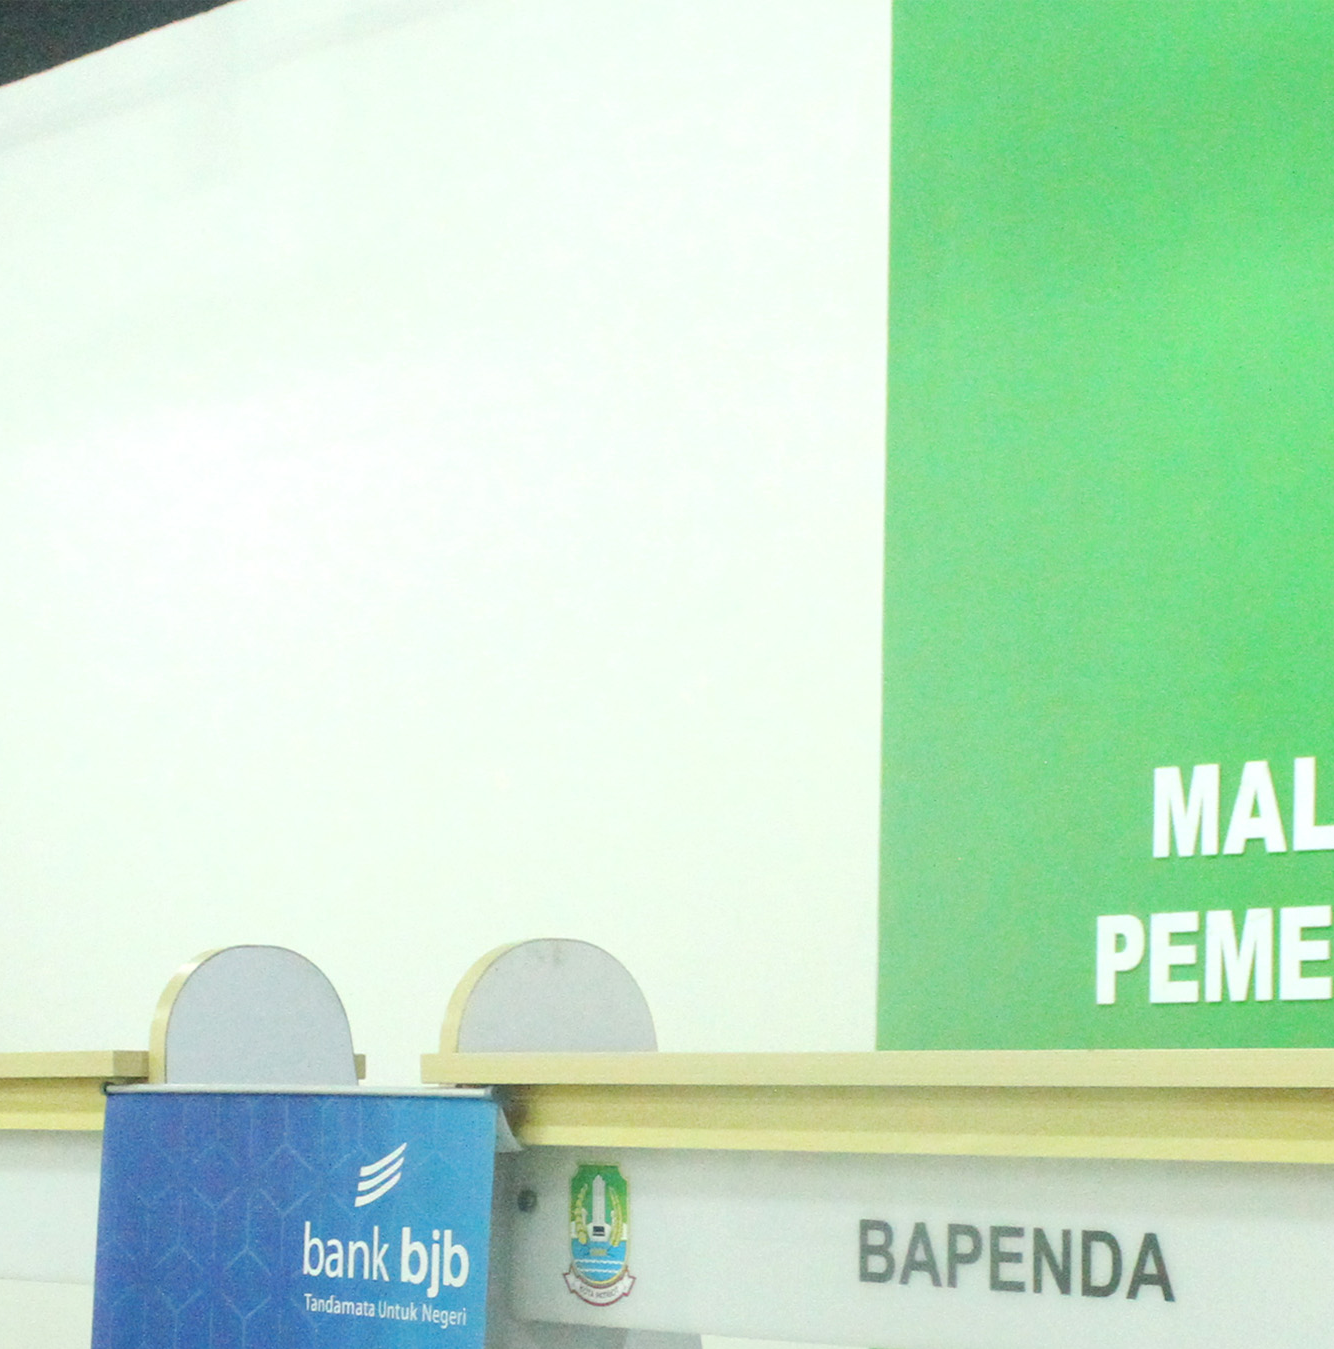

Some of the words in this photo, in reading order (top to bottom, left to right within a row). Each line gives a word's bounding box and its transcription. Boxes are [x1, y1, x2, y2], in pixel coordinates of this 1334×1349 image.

[302, 1221, 389, 1282] bank
[401, 1227, 469, 1297] bjb
[857, 1219, 1176, 1302] BAPENDA
[304, 1293, 375, 1318] Tandamata
[378, 1301, 418, 1322] Untuk
[422, 1307, 466, 1329] Negeri
